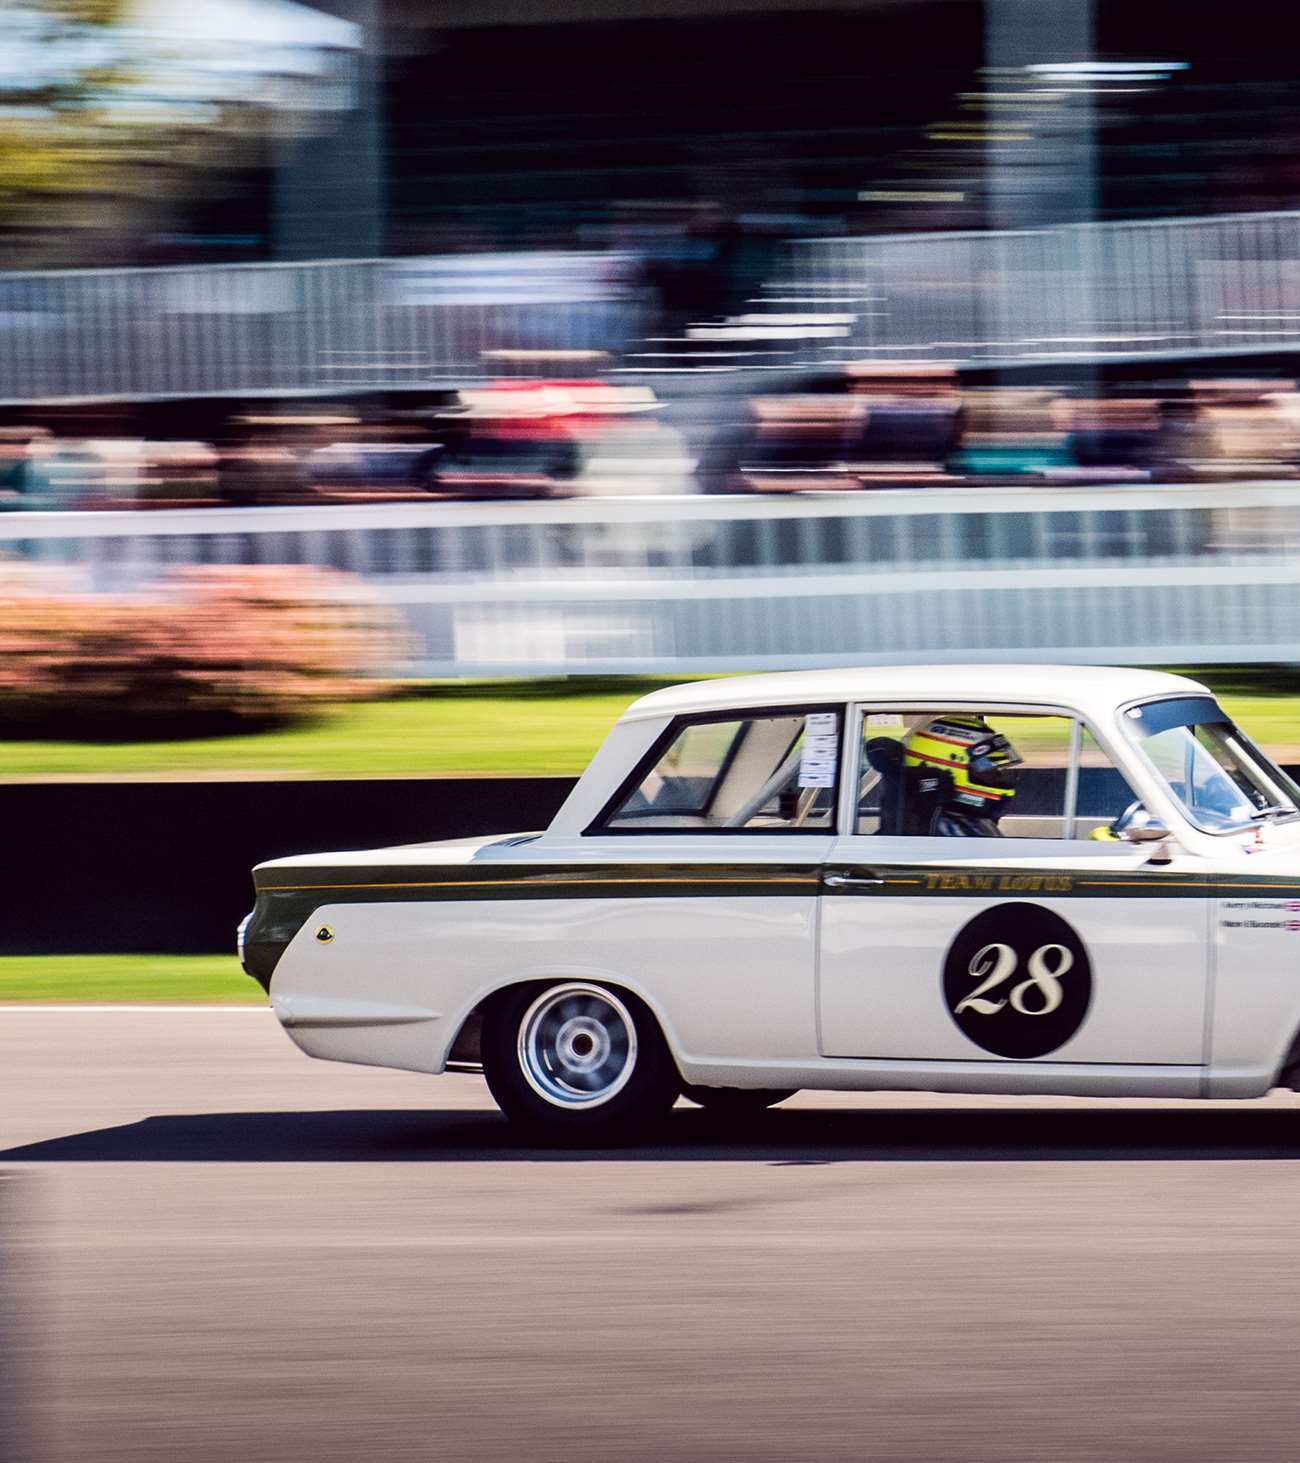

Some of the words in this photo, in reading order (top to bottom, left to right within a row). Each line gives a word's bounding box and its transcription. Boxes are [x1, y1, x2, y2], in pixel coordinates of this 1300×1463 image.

[926, 873, 993, 890] TEAM
[998, 875, 1073, 891] LOTUS
[954, 943, 1075, 1016] 28
